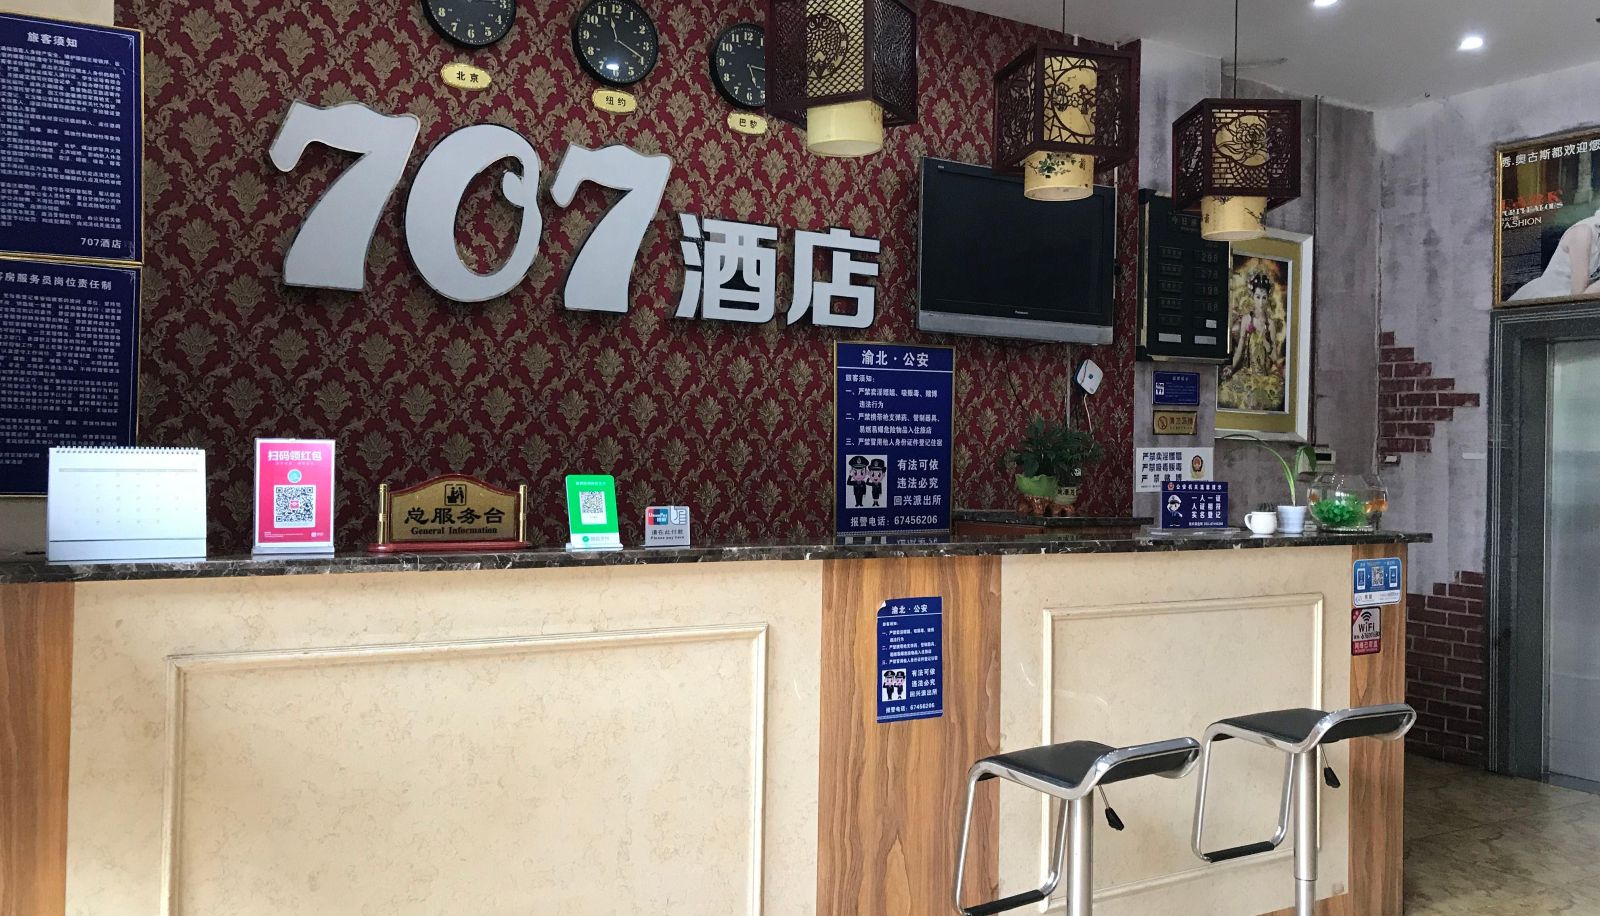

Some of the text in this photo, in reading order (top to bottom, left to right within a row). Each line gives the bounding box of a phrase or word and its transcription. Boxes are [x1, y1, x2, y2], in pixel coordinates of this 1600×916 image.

[438, 8, 446, 17] 8
[597, 6, 606, 15] 11
[611, 4, 622, 14] 12
[495, 15, 502, 25] 4
[586, 14, 598, 25] 10
[629, 11, 635, 21] 1
[451, 22, 458, 32] 7
[484, 26, 492, 37] 5
[638, 25, 646, 35] 2
[467, 29, 475, 39] 6
[582, 29, 590, 40] 9
[731, 33, 740, 43] 11
[743, 31, 754, 41] 12
[27, 32, 78, 48] 旅客须知
[587, 46, 594, 56] 8
[642, 41, 650, 51] 3
[721, 42, 733, 52] 10
[719, 57, 726, 67] 9
[627, 66, 634, 76] 5
[456, 71, 479, 83] 北京
[723, 72, 730, 82] 8
[733, 86, 739, 95] 7
[605, 96, 627, 107] 纽约
[746, 92, 753, 101] 6
[80, 237, 121, 249] 707酒店
[861, 349, 929, 367] 渝北·公安
[859, 400, 884, 409] 违法行为
[268, 450, 322, 461] 扫码领红包
[897, 458, 939, 471] 有法可依
[897, 477, 939, 489] 违法必究
[893, 494, 942, 506] 回兴派出所
[1191, 494, 1221, 502] 一人一证
[404, 507, 506, 525] 总服务台
[1191, 511, 1221, 519] 实名登记
[411, 526, 498, 535] General Information
[911, 668, 936, 677] 有法可依
[911, 678, 936, 688] 违法必究
